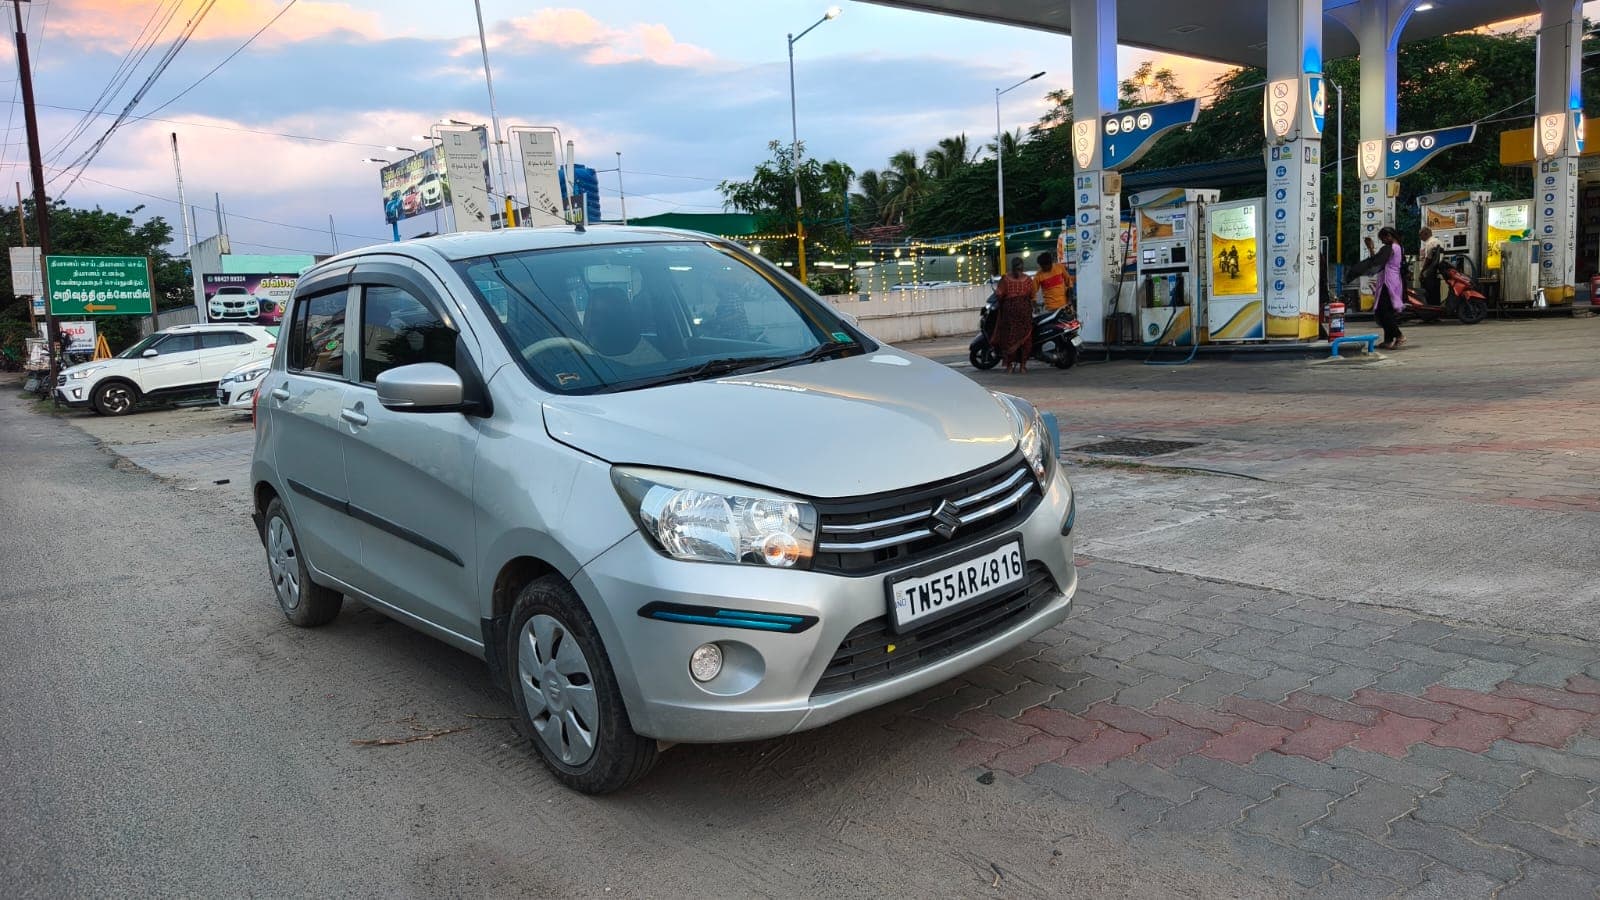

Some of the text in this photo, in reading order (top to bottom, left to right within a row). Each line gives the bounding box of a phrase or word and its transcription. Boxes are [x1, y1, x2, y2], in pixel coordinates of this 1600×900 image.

[1109, 144, 1115, 157] 1
[1393, 160, 1400, 170] 3
[53, 288, 150, 302] அறிவுத்திருக்கோயில்
[905, 551, 1021, 615] TN55AR4816
